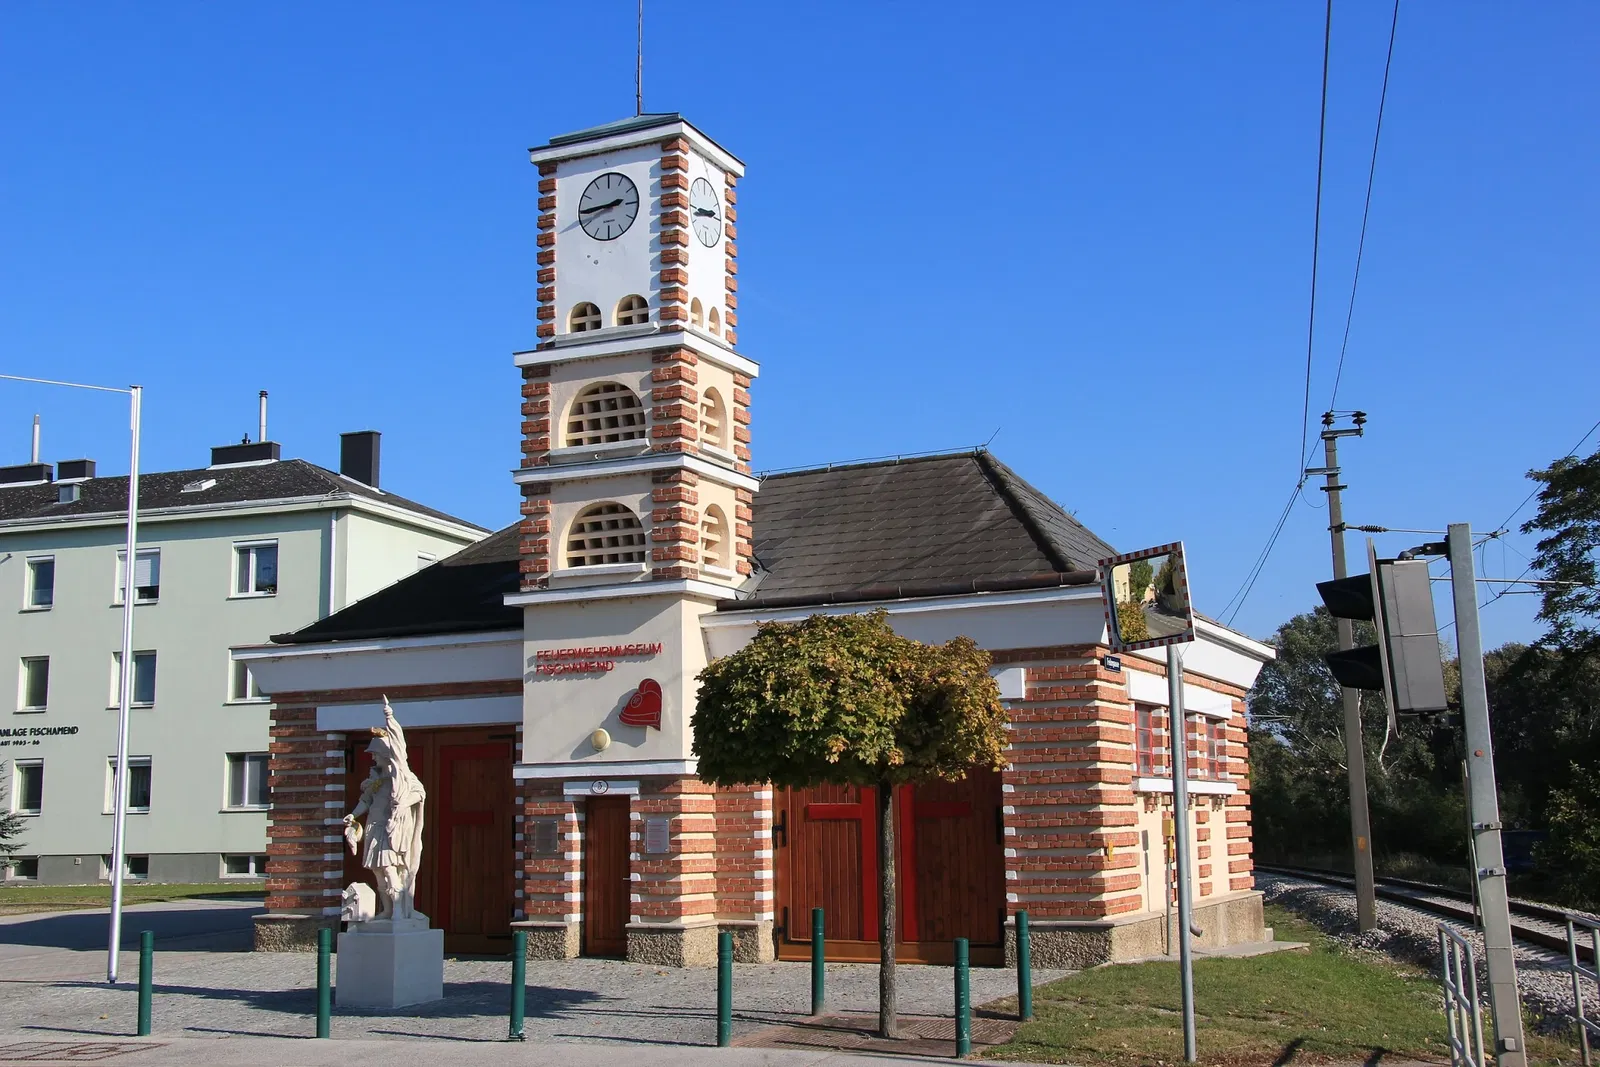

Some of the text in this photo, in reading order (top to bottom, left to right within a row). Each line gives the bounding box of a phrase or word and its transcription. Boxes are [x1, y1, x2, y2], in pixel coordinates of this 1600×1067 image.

[536, 642, 662, 662] FEUERWEHRMUSEUM
[535, 660, 614, 676] FISCHAMEND
[29, 725, 79, 736] FISCHAMEND
